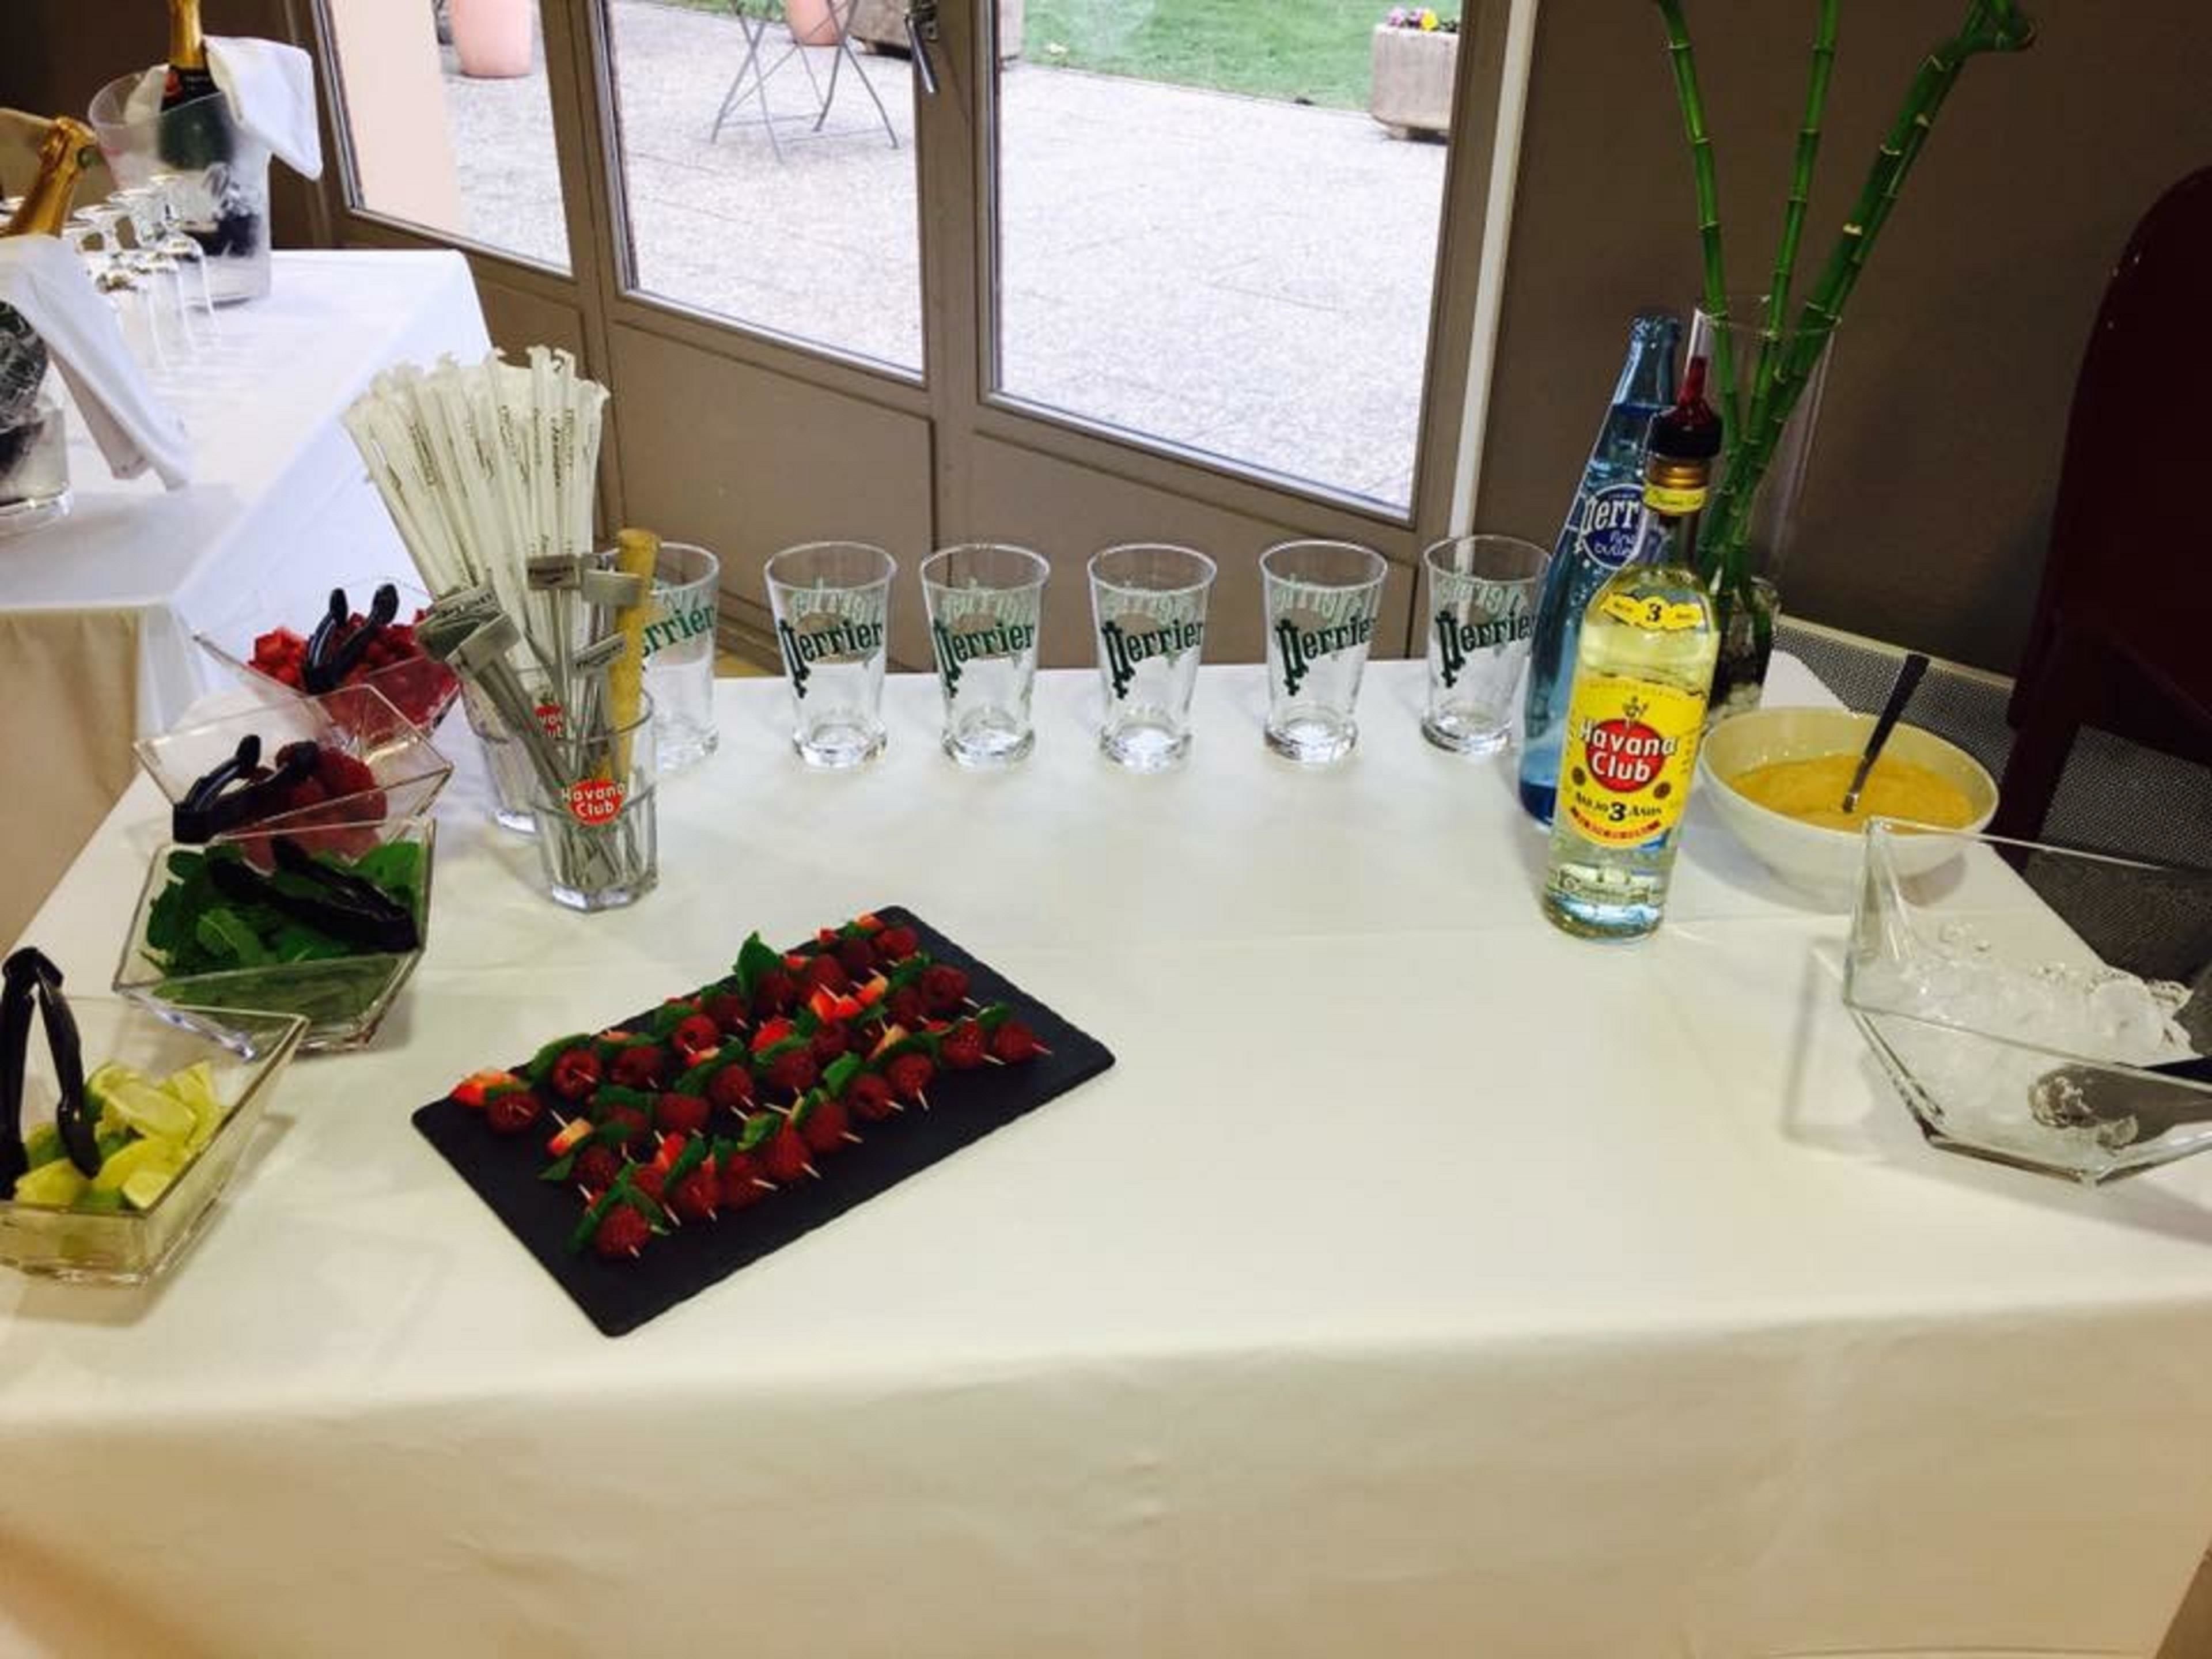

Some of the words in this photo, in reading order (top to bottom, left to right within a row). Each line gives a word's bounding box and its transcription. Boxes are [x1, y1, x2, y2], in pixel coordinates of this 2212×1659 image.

[1575, 495, 1639, 554] Perr
[641, 605, 715, 658] rrier
[1646, 603, 1662, 622] 3
[778, 618, 883, 699] Perrier
[933, 618, 1035, 699] Perrier
[1275, 615, 1377, 696] Perrie
[1435, 609, 1536, 689] Perrie
[1580, 718, 1678, 756] Havana
[1592, 751, 1651, 782] Club
[562, 782, 626, 802] Havana
[576, 799, 614, 817] Club
[1608, 801, 1626, 821] 3
